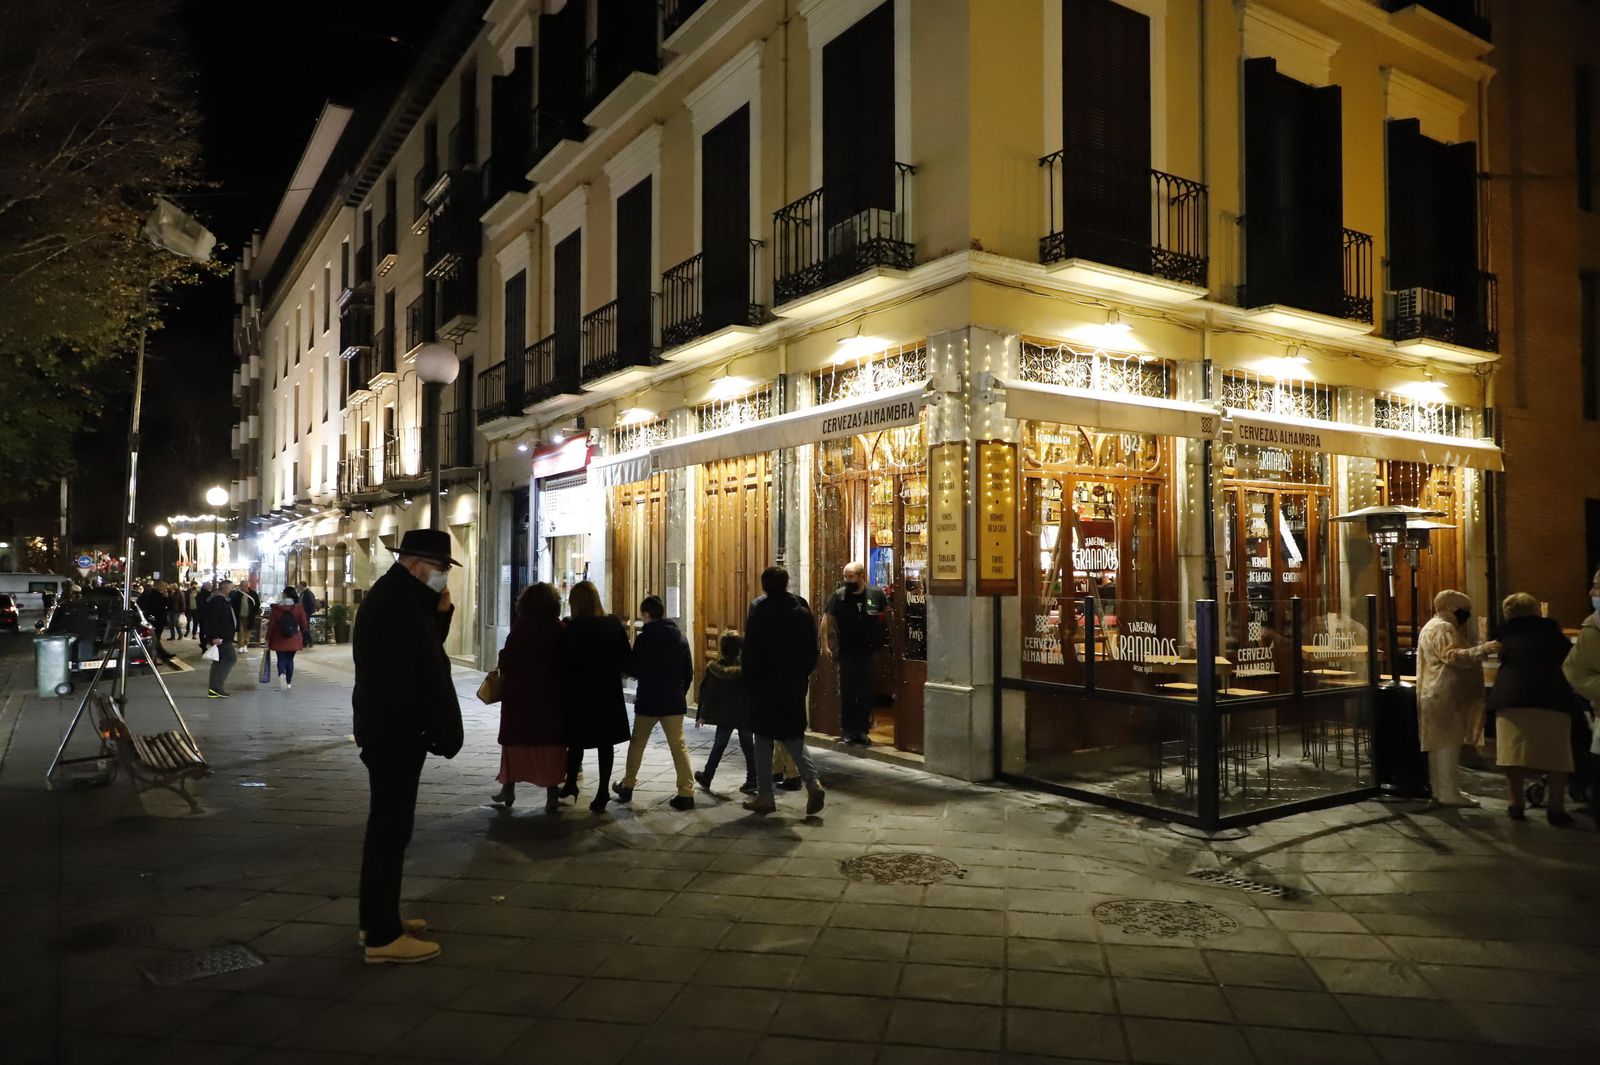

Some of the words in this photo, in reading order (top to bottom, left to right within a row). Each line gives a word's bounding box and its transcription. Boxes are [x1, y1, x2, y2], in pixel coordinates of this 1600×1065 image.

[822, 412, 861, 434] CERVEZAS
[863, 402, 915, 426] ALHAMBRA
[1239, 425, 1278, 443] CERVEZAS
[1279, 430, 1321, 448] ALHAMBRA
[1257, 450, 1293, 473] GRANADOS
[1084, 536, 1106, 548] TABERNA
[1072, 548, 1119, 571] GRANADOS
[906, 591, 926, 606] QUESOS
[1127, 621, 1157, 635] TABERNA
[1024, 636, 1062, 651] CERVEZAS
[1111, 634, 1178, 666] GRANADOS
[1022, 650, 1065, 666] ALHAMBRA
[1237, 646, 1273, 662] CERVEZAS
[1235, 661, 1275, 678] ALHAMBRA
